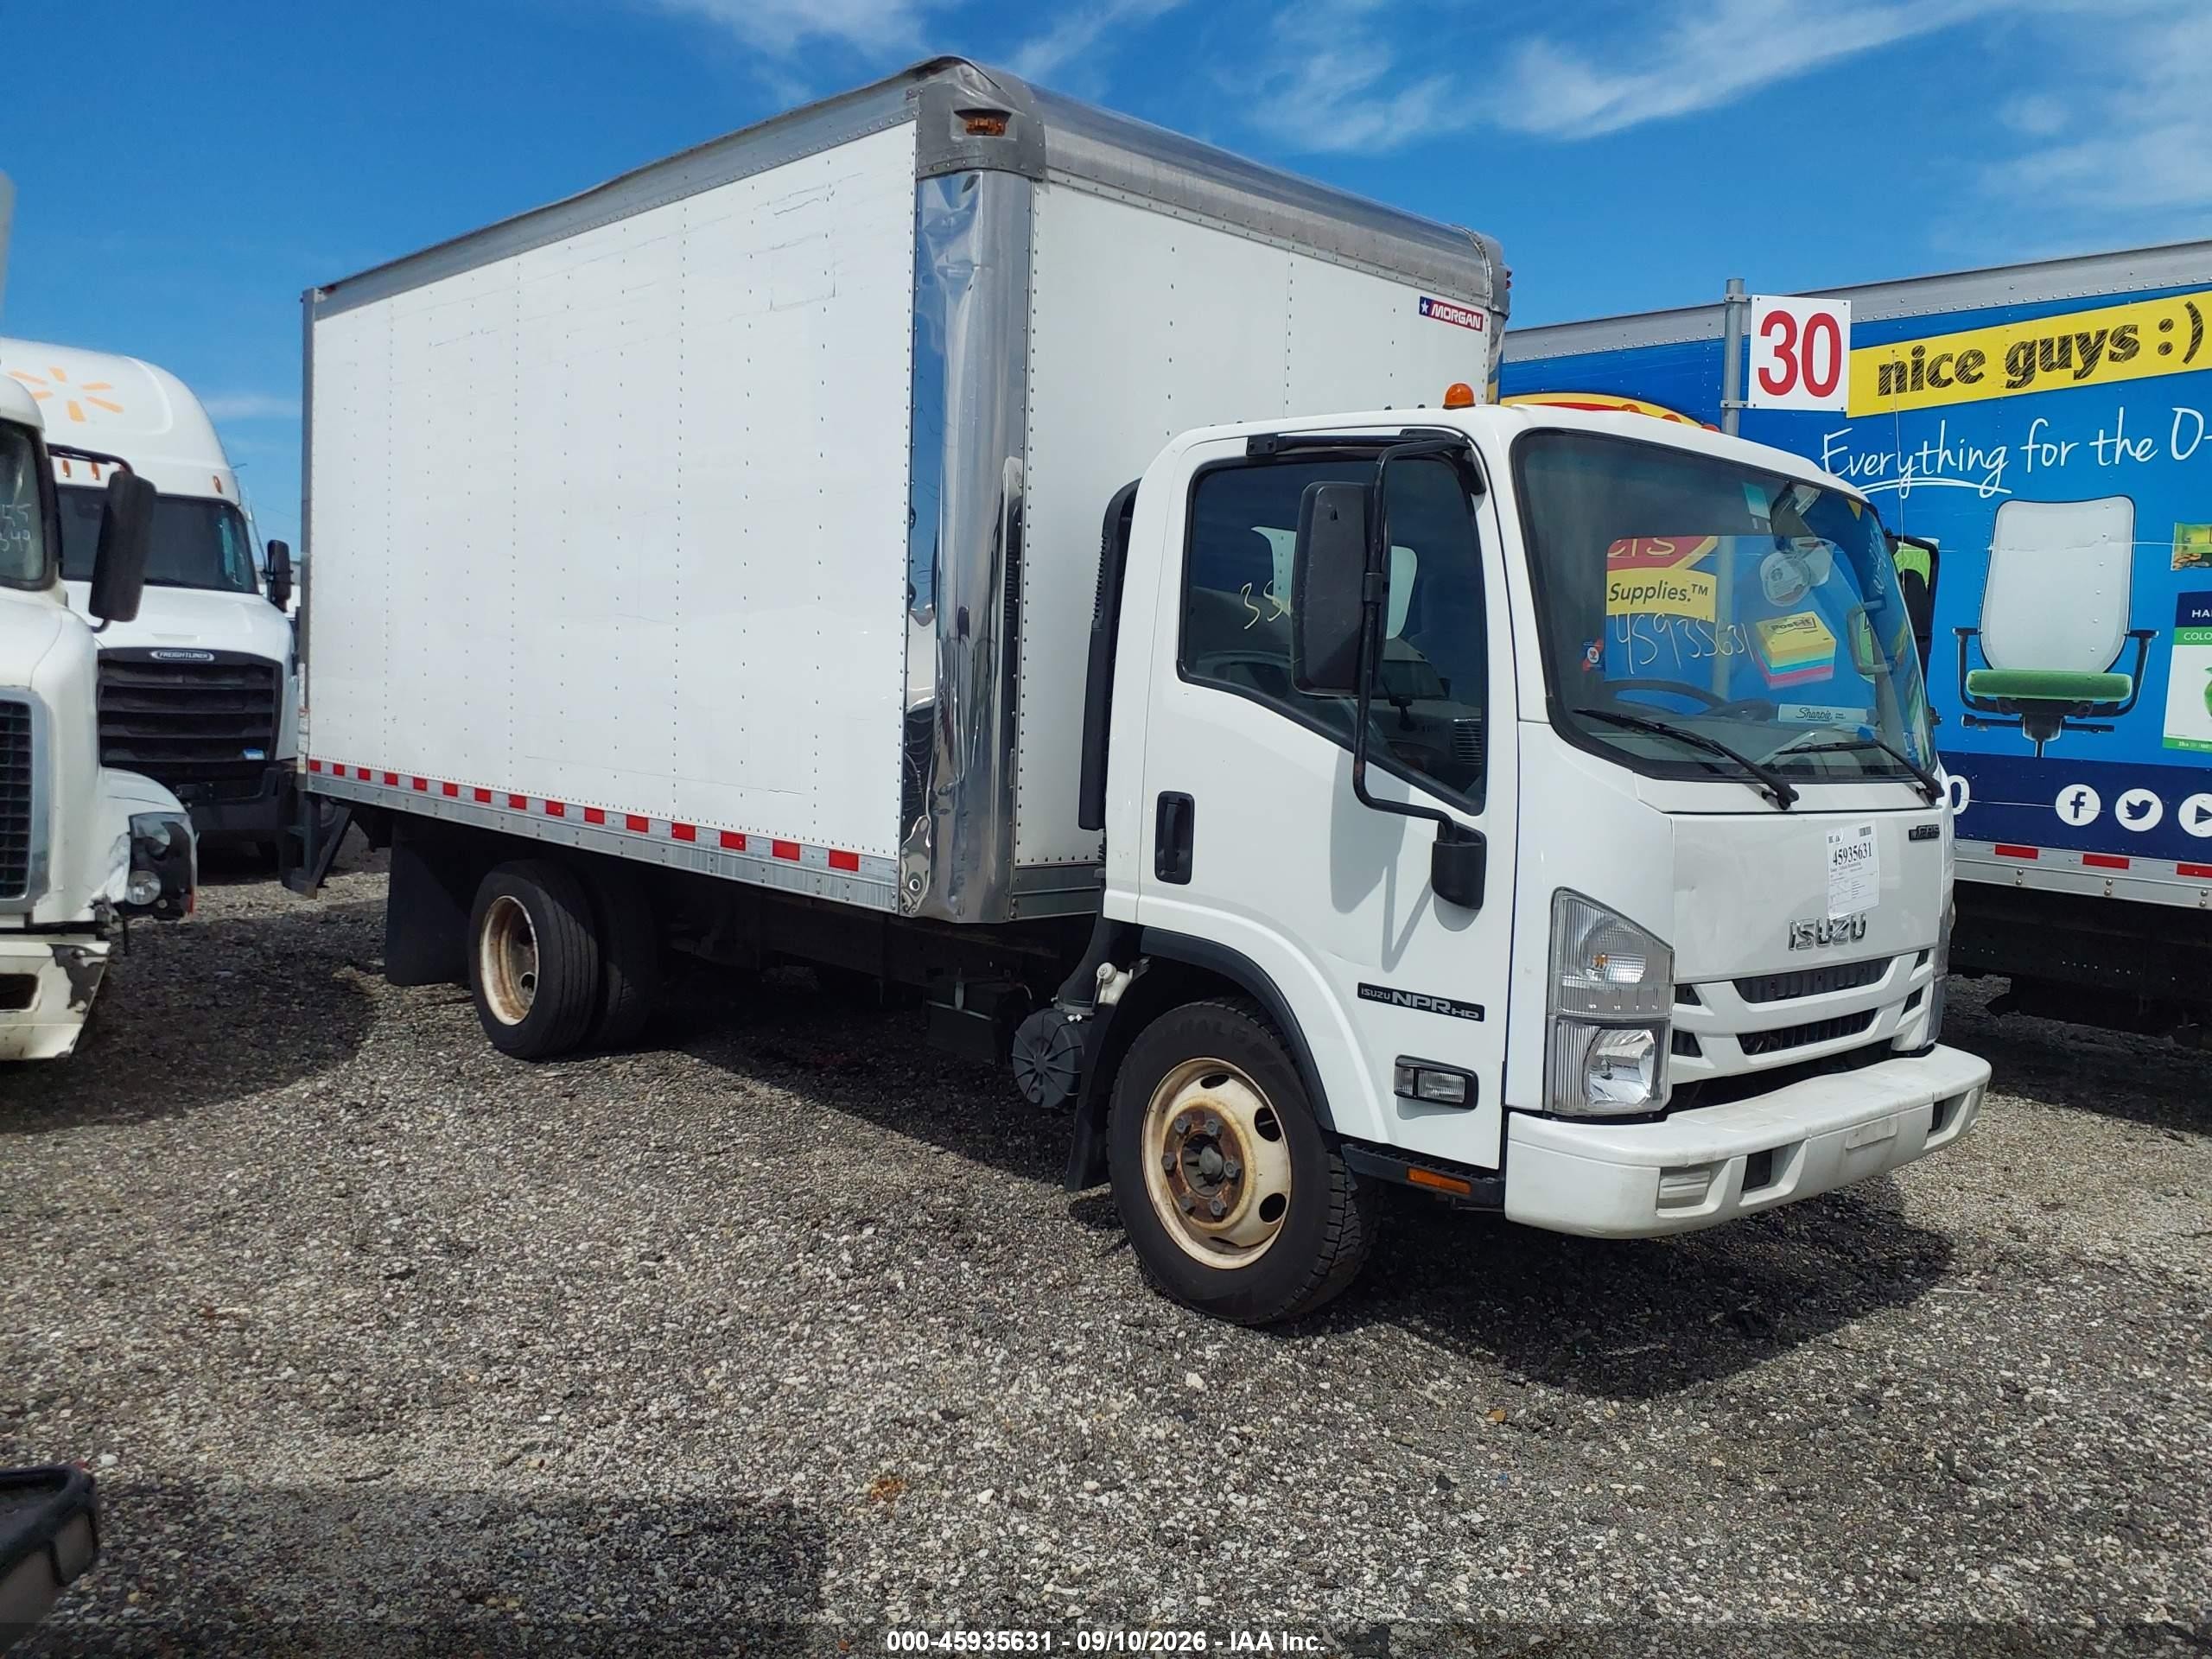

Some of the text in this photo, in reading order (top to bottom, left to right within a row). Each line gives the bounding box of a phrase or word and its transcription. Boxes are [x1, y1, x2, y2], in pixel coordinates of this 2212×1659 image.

[1431, 303, 1481, 328] MORGAN
[1758, 309, 1842, 397] 30
[1878, 345, 1986, 397] nice
[2005, 324, 2140, 389] guys
[1821, 406, 2212, 499] Everything for the O
[2191, 608, 2212, 618] HA
[1616, 612, 1754, 675] 45935631
[1796, 707, 1833, 721] Sharpie
[1833, 841, 1872, 867] 45935631
[1789, 912, 1866, 951] ISUZU
[1361, 988, 1480, 1020] ISUZU NPR HD
